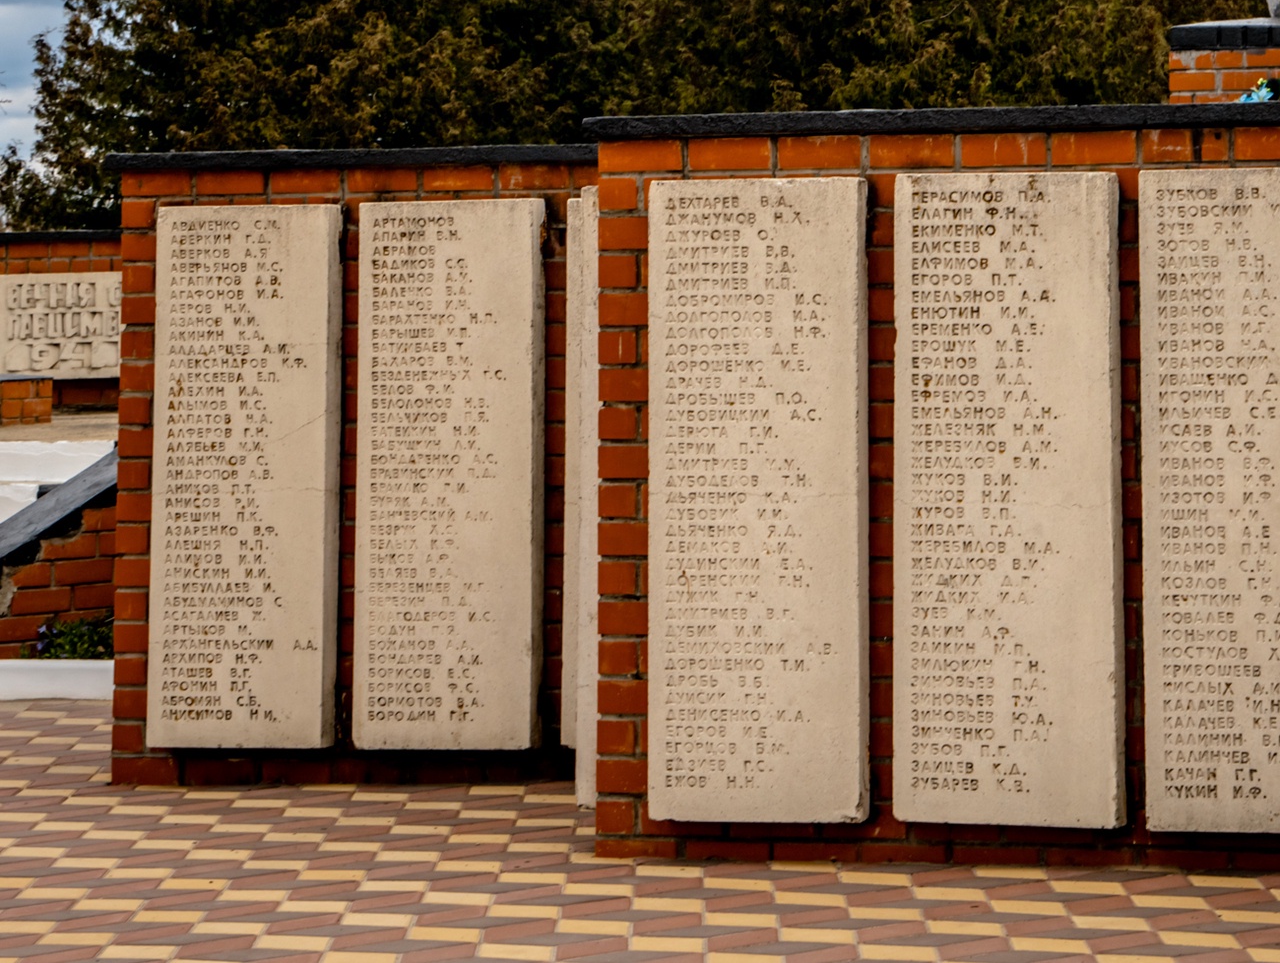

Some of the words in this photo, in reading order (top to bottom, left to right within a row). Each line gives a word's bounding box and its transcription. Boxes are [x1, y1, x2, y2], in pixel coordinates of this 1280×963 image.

[912, 191, 1003, 203] ГЕРАСИМОВ
[1156, 189, 1217, 201] ЗУБКОВ
[1235, 187, 1266, 200] В.В.
[666, 213, 756, 227] ДЖАНУМОВ
[171, 234, 231, 245] АВЕРКИН
[246, 234, 271, 244] Г.Д.
[1158, 239, 1209, 252] ЗОТОВ
[1226, 239, 1257, 250] Н.В.
[373, 245, 435, 256] АБРАМОВ
[912, 241, 980, 253] ЕЛИСЕЕВ
[1000, 241, 1035, 253] М.А.
[371, 259, 434, 270] БАДИКОВ
[666, 278, 748, 291] ДМИТРИЕВ
[7, 282, 97, 310] ВЕЧНАЯ
[171, 290, 244, 300] АГАФОНОВ
[257, 289, 283, 299] И.А.
[911, 307, 980, 319] ЕНЮТИН
[1001, 307, 1034, 318] И.И.
[7, 310, 103, 340] ПАВШИМ
[170, 317, 222, 327] АЗАНОВ
[234, 317, 259, 326] И.И.
[665, 343, 749, 356] ДОРОФЕЕВ
[772, 343, 804, 355] Д.Е.
[912, 340, 976, 352] ЕРОШУК
[996, 340, 1030, 352] М.Е.
[169, 358, 267, 368] АЛЕКСАНДРОВ
[282, 358, 307, 368] К.Ф.
[912, 357, 976, 368] ЕФАНОВ
[995, 357, 1032, 369] Д.А.
[170, 372, 244, 385] АЛЕКСЕЕВА
[257, 372, 279, 382] Е.П.
[666, 393, 755, 406] ДРОБЫШЕВ
[776, 392, 807, 404] П.О.
[1159, 407, 1231, 420] ИЛЬИЧЕВ
[912, 423, 996, 436] ЖЕЛЕЗНЯК
[1013, 424, 1051, 436] Н.М.
[1160, 424, 1212, 436] ИСАЕВ
[1226, 424, 1261, 436] А.И.
[740, 442, 767, 454] П.Г.
[371, 454, 459, 465] БОНДАРЕНКО
[474, 453, 497, 464] А.С.
[167, 470, 238, 480] АНДРОПОВ
[250, 469, 274, 480] А.В.
[912, 473, 965, 485] ЖУКОВ
[984, 474, 1018, 486] В.И.
[166, 512, 220, 522] АРЕШИН
[237, 512, 262, 522] П.К.
[165, 525, 238, 536] АЗАРЕНКО
[254, 526, 278, 536] В.Ф.
[665, 525, 747, 537] ДЬЯЧЕНКО
[767, 525, 802, 538] Я.Д.
[1161, 577, 1227, 589] КОЗЛОВ
[1248, 577, 1280, 589] Г.Н.
[1163, 629, 1237, 642] КОНЬКОВ
[369, 640, 435, 650] БОЖАНОВ
[163, 653, 222, 663] АРХИПОВ
[236, 654, 262, 664] Н.Ф.
[369, 653, 441, 665] БОНДАРЕВ
[369, 683, 430, 693] БОРИСОВ
[368, 711, 435, 721] БОРОДИН
[450, 710, 473, 721] Г.Г.
[666, 709, 760, 721] ДЕНИСЕНКО
[777, 710, 810, 722] И.А.
[1164, 717, 1235, 729] КАЛАЧЕВ
[666, 725, 726, 737] ЕГОРОВ
[911, 743, 962, 755] ЗУБОВ
[981, 745, 1009, 756] П.Г.
[993, 763, 1026, 776] К.Д.
[1165, 768, 1216, 781] КАЧАН
[1235, 769, 1261, 781] Г.Г.
[666, 775, 706, 788] ЕЖОВ
[727, 776, 759, 788] Н.Н.
[1165, 785, 1217, 798] КУКИН
[1233, 786, 1267, 799] И.Ф.
